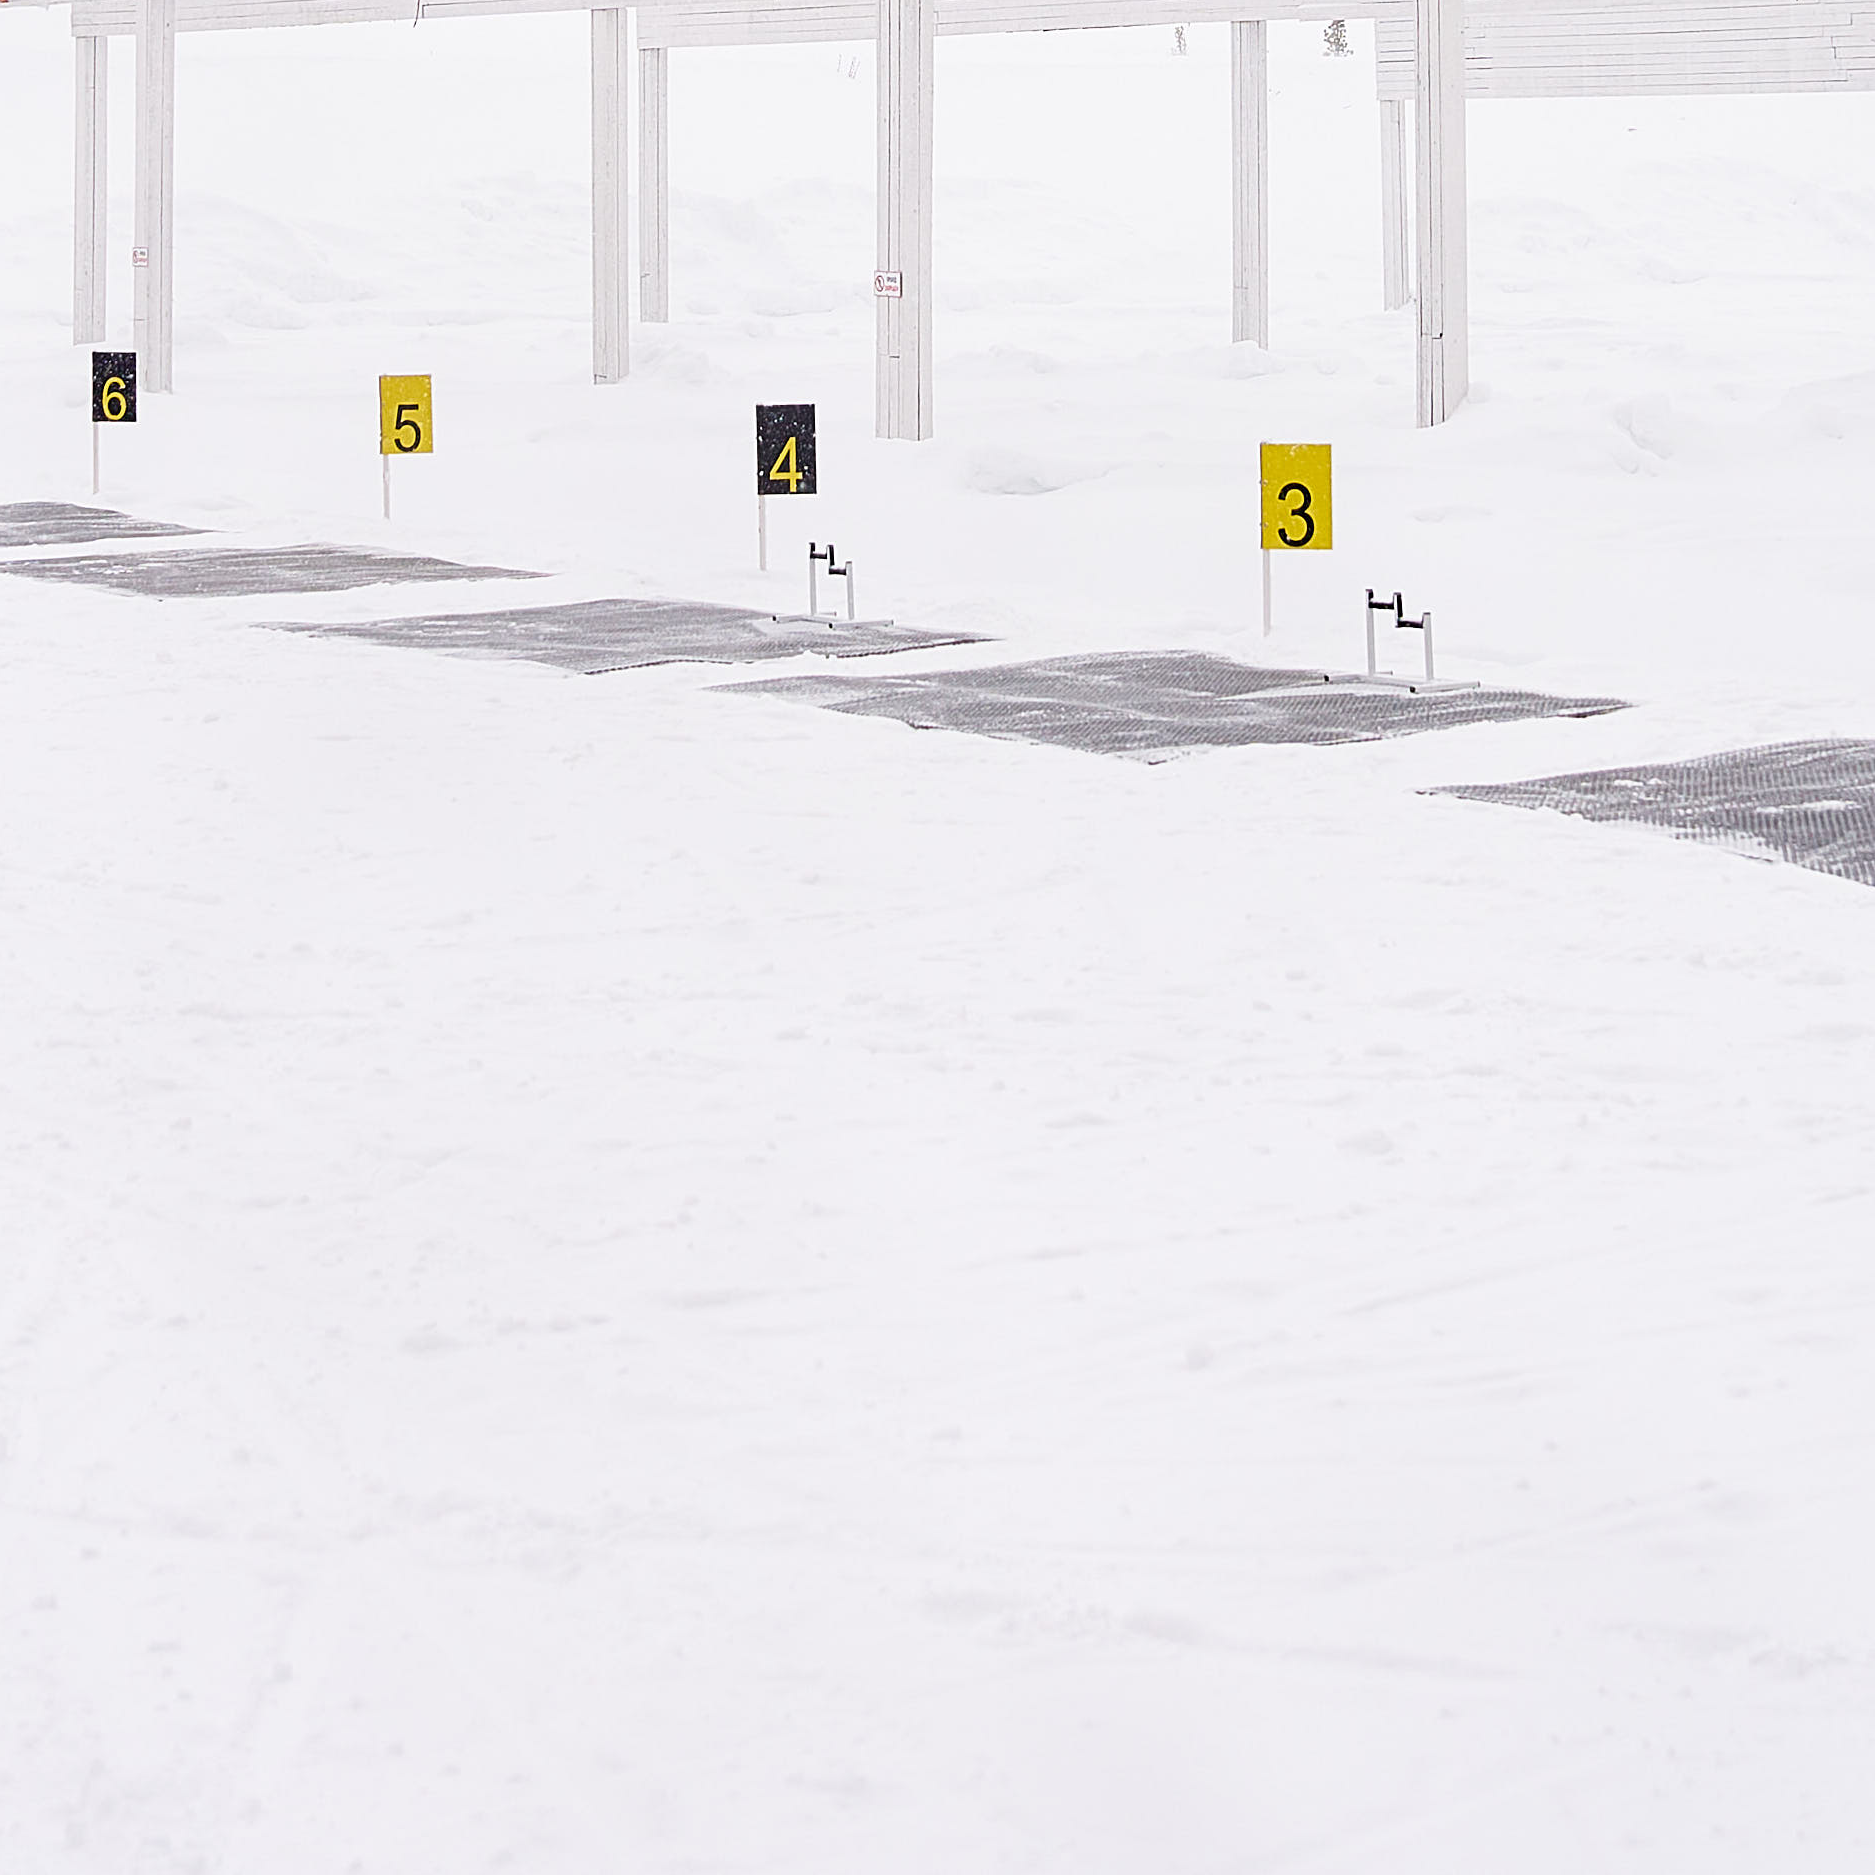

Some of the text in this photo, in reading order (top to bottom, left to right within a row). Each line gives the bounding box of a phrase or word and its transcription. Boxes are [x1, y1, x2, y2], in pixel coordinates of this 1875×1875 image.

[101, 376, 127, 421] 6
[394, 403, 422, 453] 5
[768, 436, 804, 493] 4
[1277, 482, 1315, 548] 3
